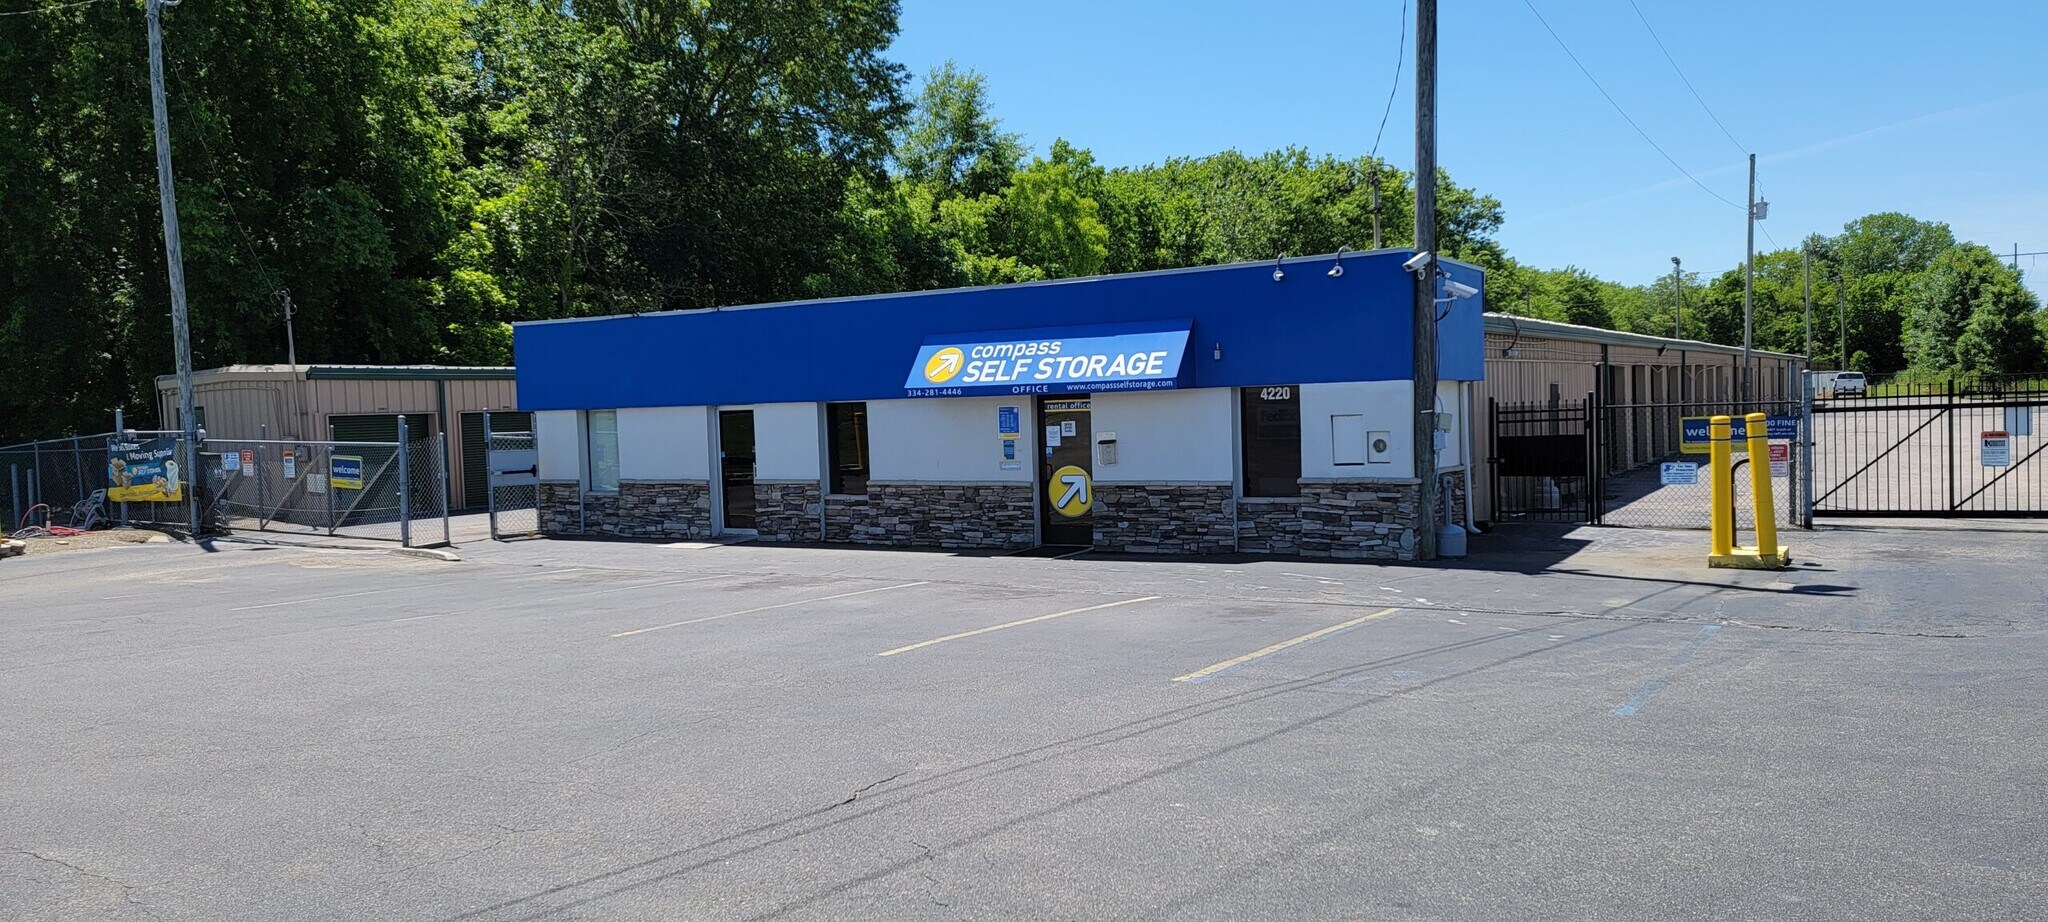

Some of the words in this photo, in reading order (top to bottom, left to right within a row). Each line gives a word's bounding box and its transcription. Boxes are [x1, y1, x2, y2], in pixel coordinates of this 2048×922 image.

[971, 340, 1062, 360] compass
[962, 359, 1033, 382] SELF
[1034, 351, 1168, 379] STORAGE
[1012, 385, 1049, 394] OFFICE
[1066, 380, 1173, 391] www.compassselfstorage.com
[907, 388, 962, 396] 334-281-4446
[1260, 387, 1290, 400] 4220
[1777, 419, 1796, 427] FINE
[1685, 425, 1746, 437] welme
[129, 450, 153, 460] Moving
[333, 465, 360, 475] welcome
